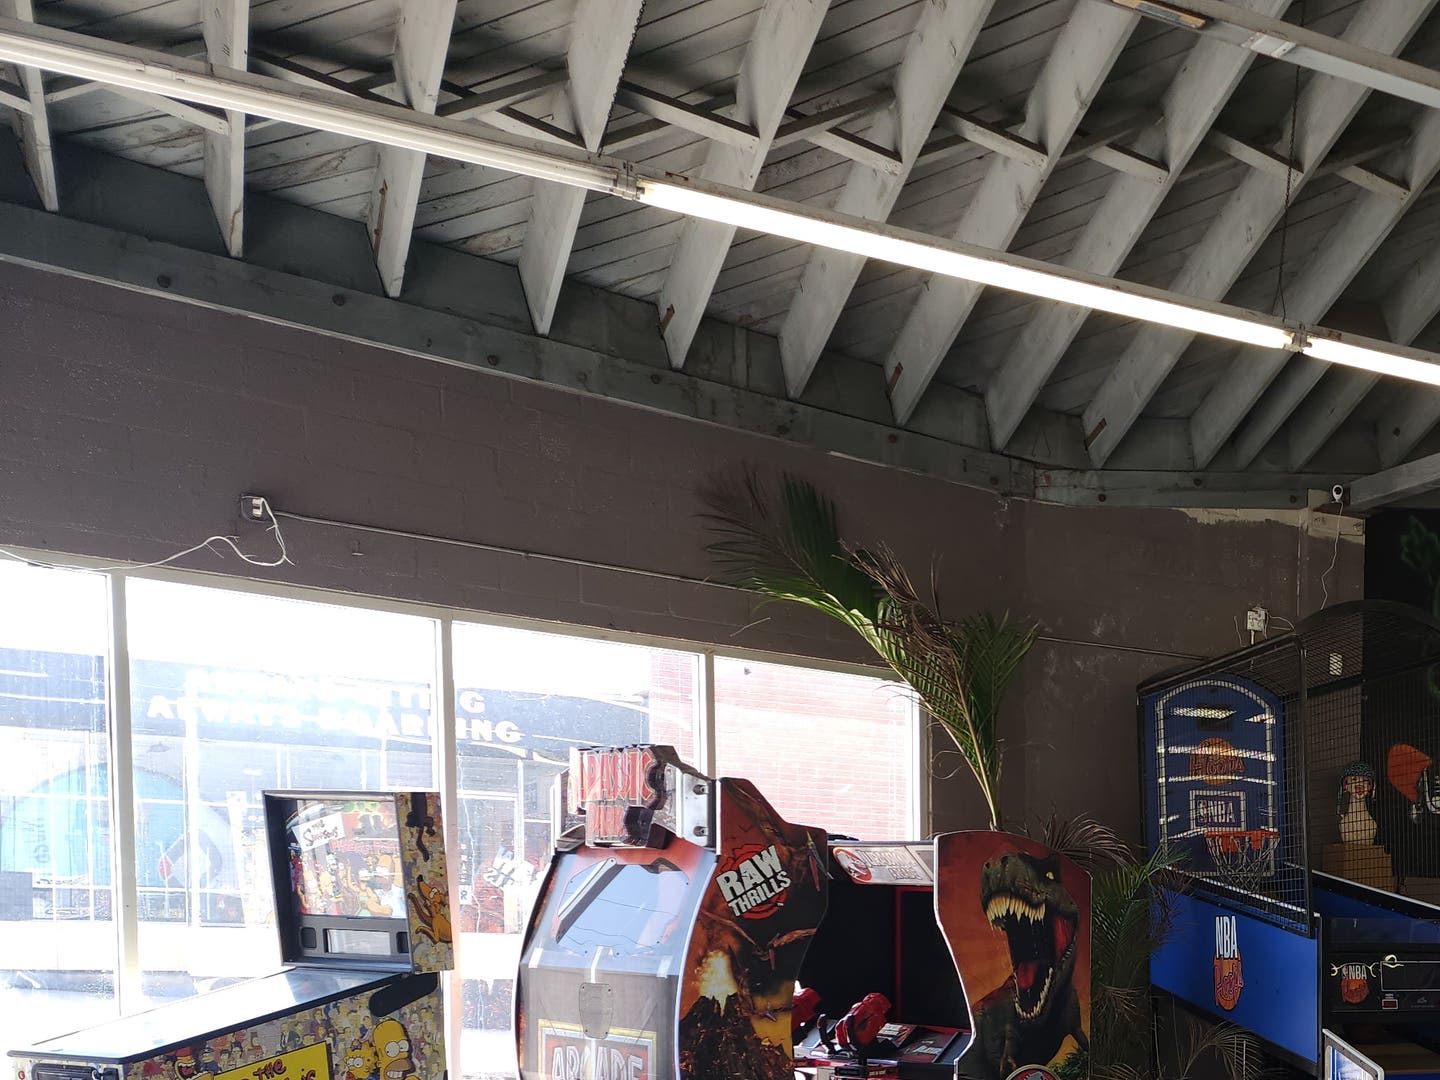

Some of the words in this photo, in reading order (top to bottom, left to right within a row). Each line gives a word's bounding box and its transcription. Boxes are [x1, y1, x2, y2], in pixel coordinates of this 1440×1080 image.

[318, 706, 521, 743] BOARING
[1208, 801, 1235, 823] NBA
[716, 845, 784, 902] RAW
[728, 870, 791, 916] THRILLS
[1216, 916, 1238, 959] NBA
[1348, 964, 1367, 980] NBA
